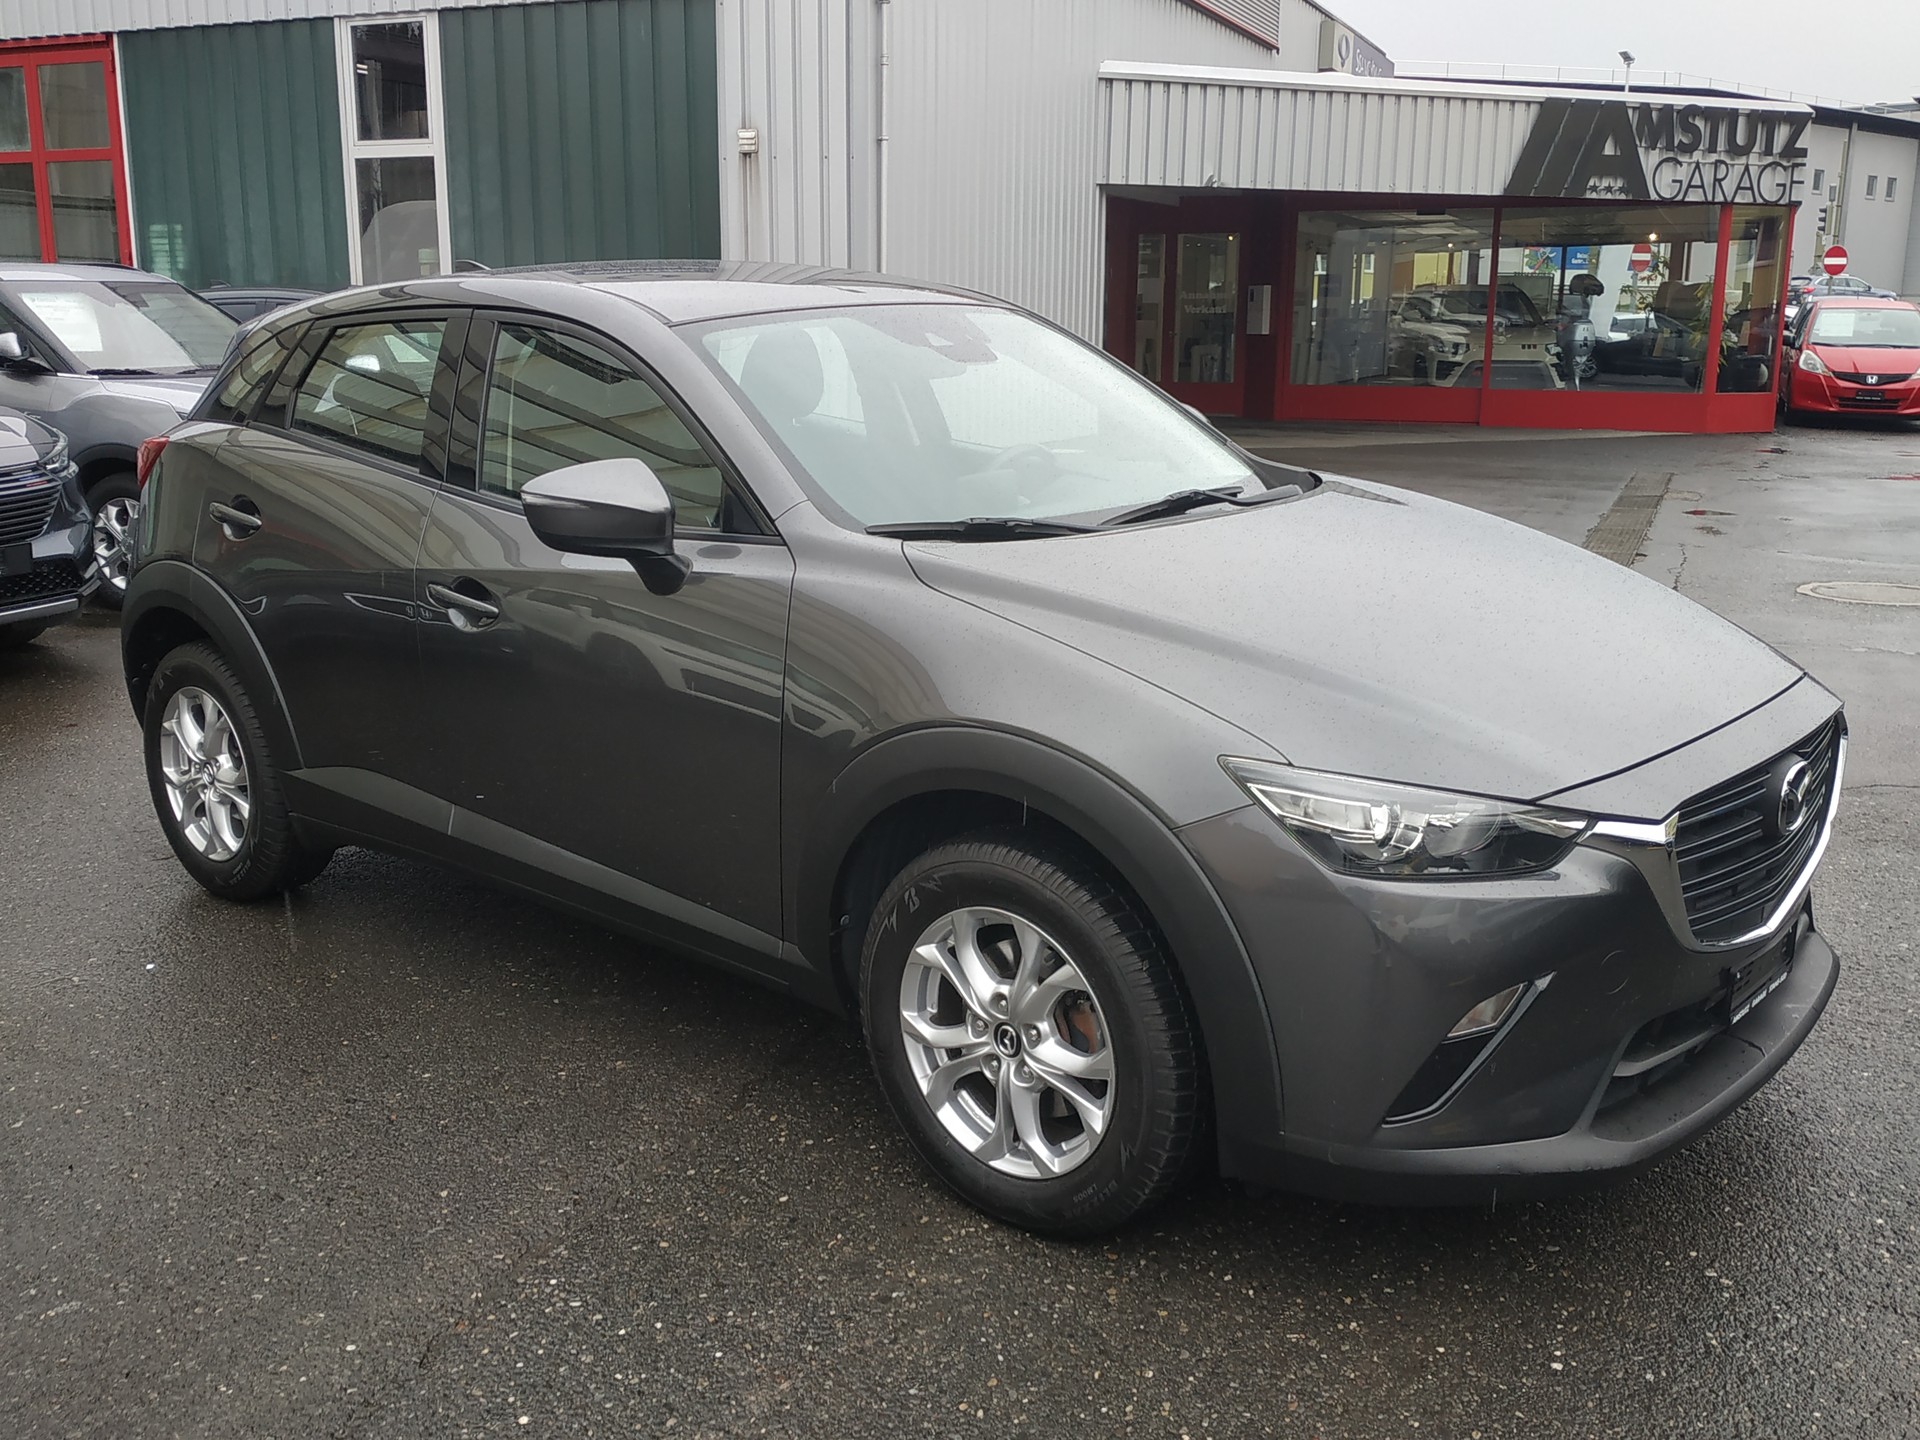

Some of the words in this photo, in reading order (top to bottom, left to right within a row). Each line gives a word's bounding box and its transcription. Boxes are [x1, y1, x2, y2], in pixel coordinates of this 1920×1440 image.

[1562, 98, 1815, 200] AMSTUTZ
[1651, 156, 1807, 205] GARAGE
[1184, 304, 1227, 314] Verkauf
